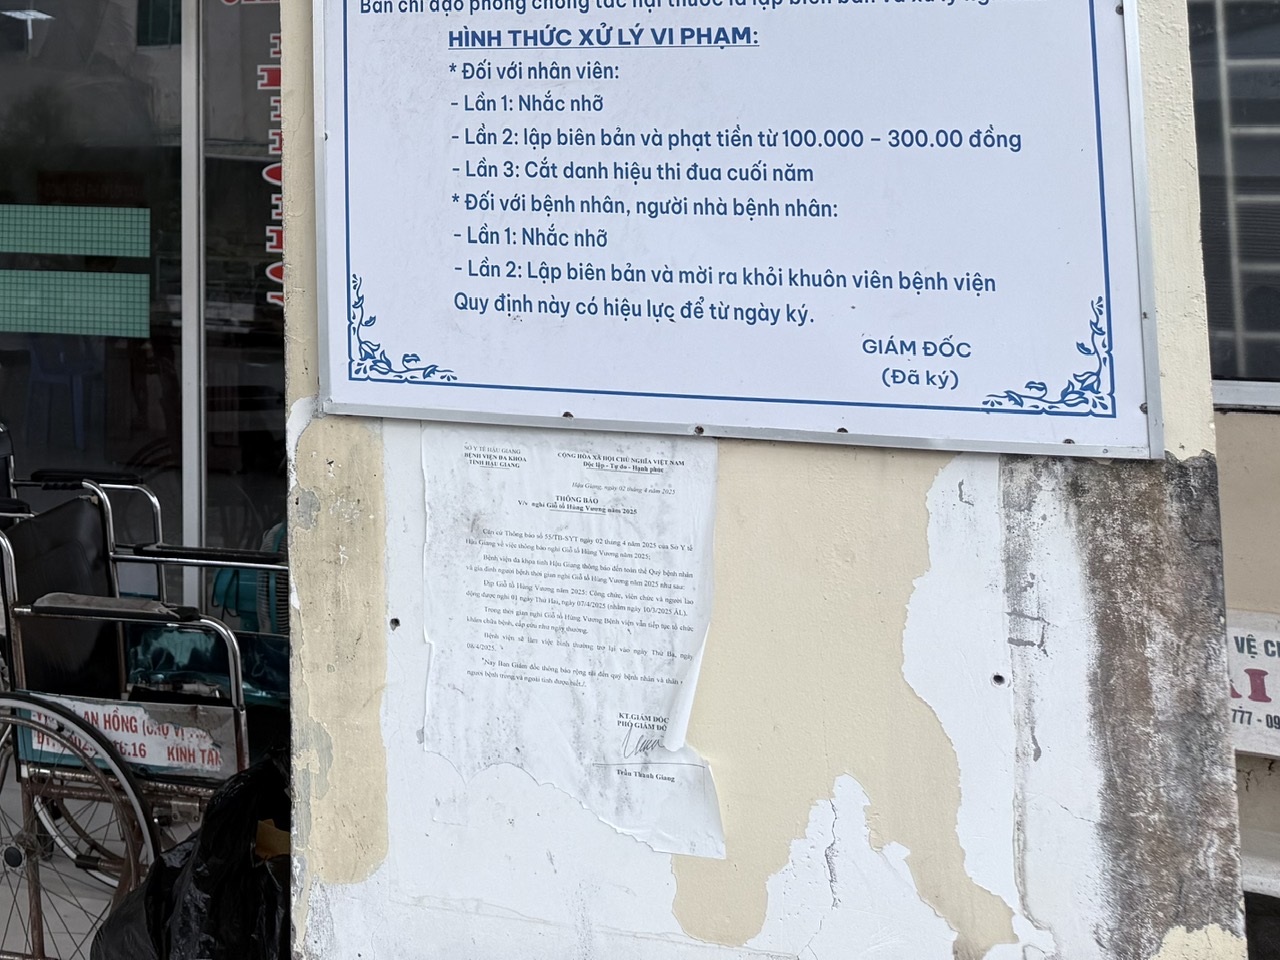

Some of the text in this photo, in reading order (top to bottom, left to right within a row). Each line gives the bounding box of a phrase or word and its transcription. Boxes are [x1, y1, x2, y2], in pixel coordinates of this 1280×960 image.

[448, 21, 760, 49] HÌNH THỨC XỬ LÝ VI PHẠM:
[861, 332, 972, 359] GIÁM ĐỐC
[881, 366, 959, 391] (Đã ký)
[1234, 634, 1257, 658] VỆ
[103, 706, 138, 733] HỒNG
